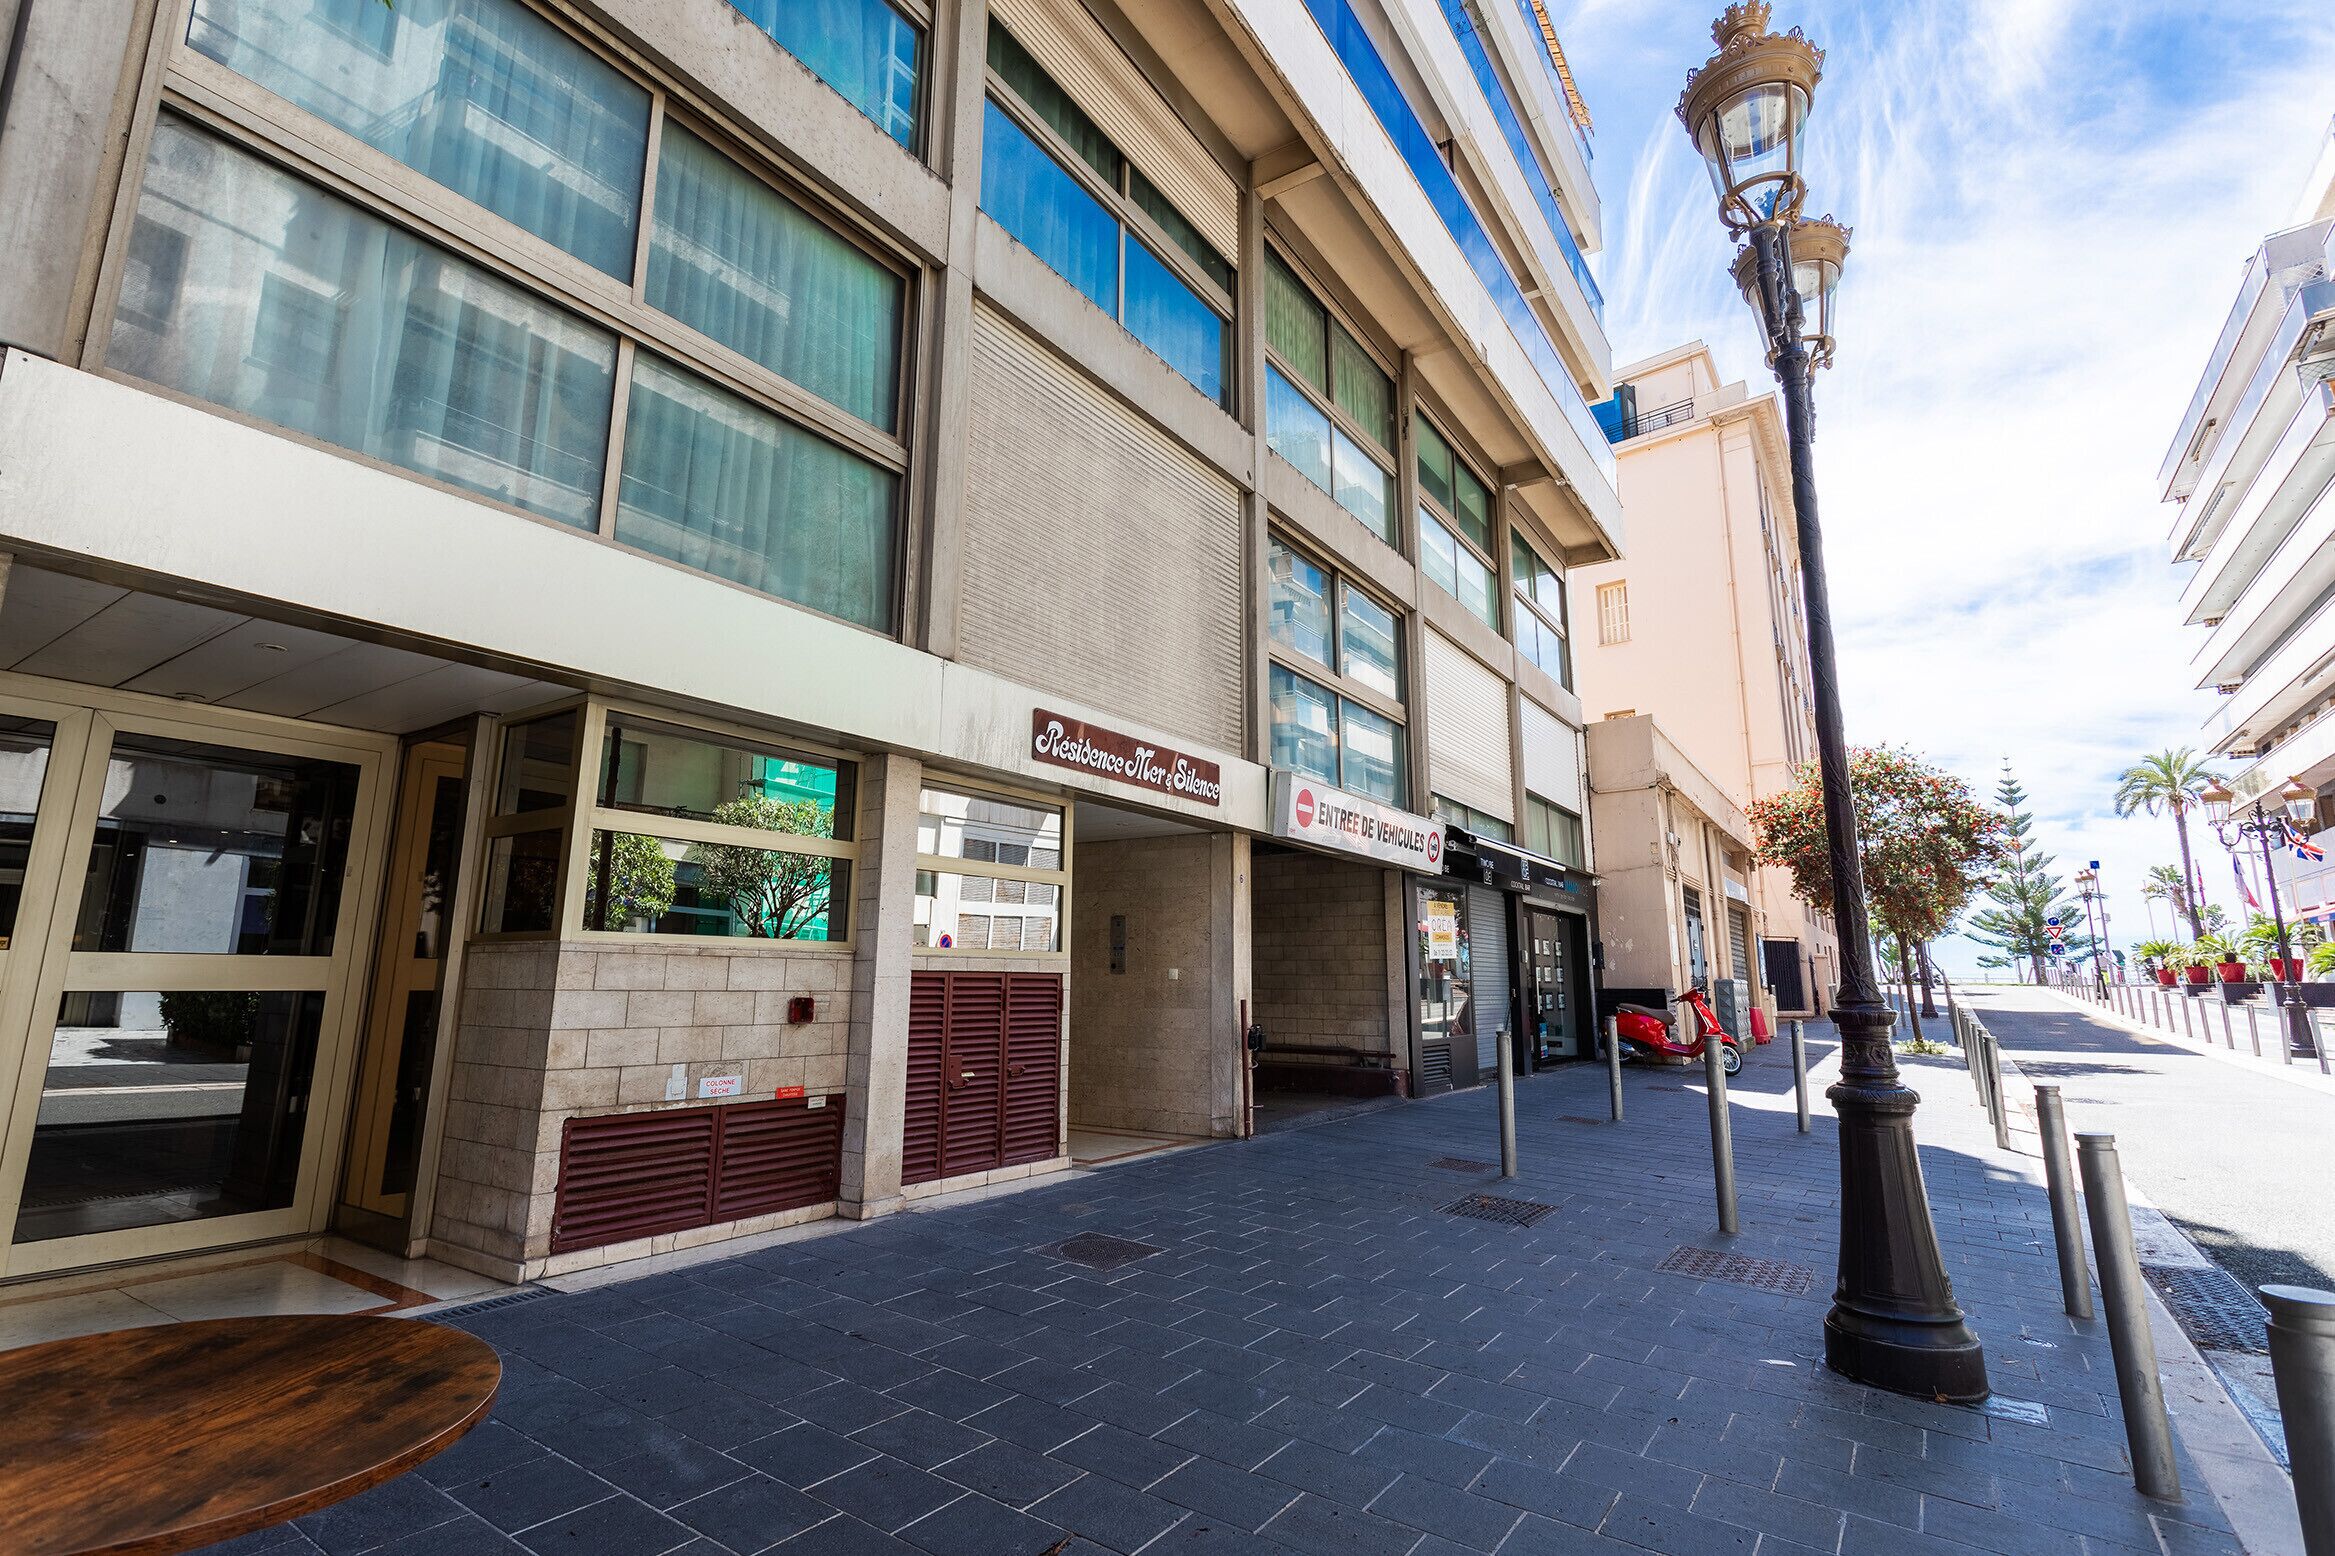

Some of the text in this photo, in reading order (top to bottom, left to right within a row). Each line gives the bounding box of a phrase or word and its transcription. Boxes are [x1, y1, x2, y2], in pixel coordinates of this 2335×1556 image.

[1035, 720, 1124, 773] Résidence
[1124, 746, 1167, 785] Mer
[1173, 758, 1220, 799] Silence
[1318, 802, 1425, 852] ENTREE DE VEHICULES
[705, 1079, 737, 1087] COLONNE
